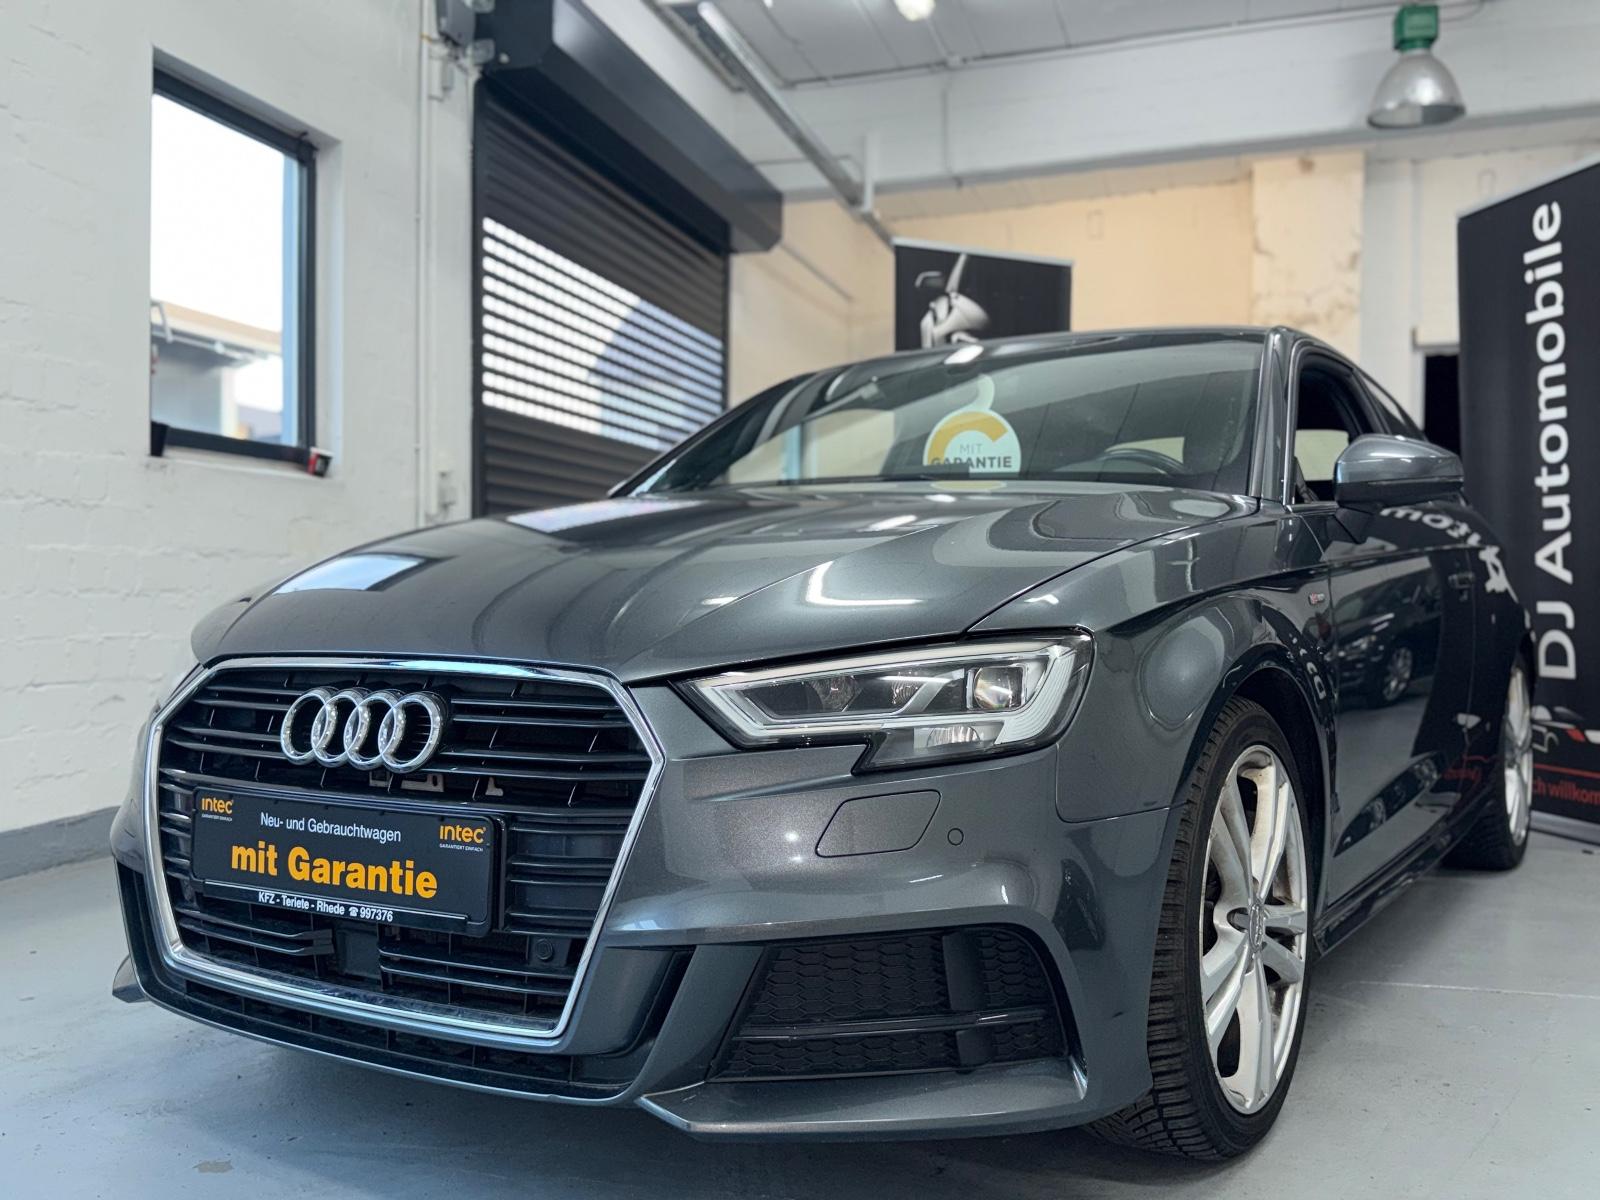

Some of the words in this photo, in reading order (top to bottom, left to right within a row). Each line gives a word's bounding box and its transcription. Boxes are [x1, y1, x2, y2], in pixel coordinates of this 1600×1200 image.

[1522, 200, 1573, 585] Automobile
[960, 443, 983, 455] MIT
[1537, 600, 1577, 680] DJ
[201, 797, 234, 815] intec
[260, 812, 284, 828] Neu-
[286, 817, 305, 832] und
[307, 818, 401, 843] Gebrauchtwagen
[439, 824, 486, 844] intec
[231, 841, 278, 876] mit
[288, 846, 438, 899] Garantie
[258, 891, 275, 905] KFZ
[316, 900, 345, 916] Rhede
[360, 905, 393, 922] 997376
